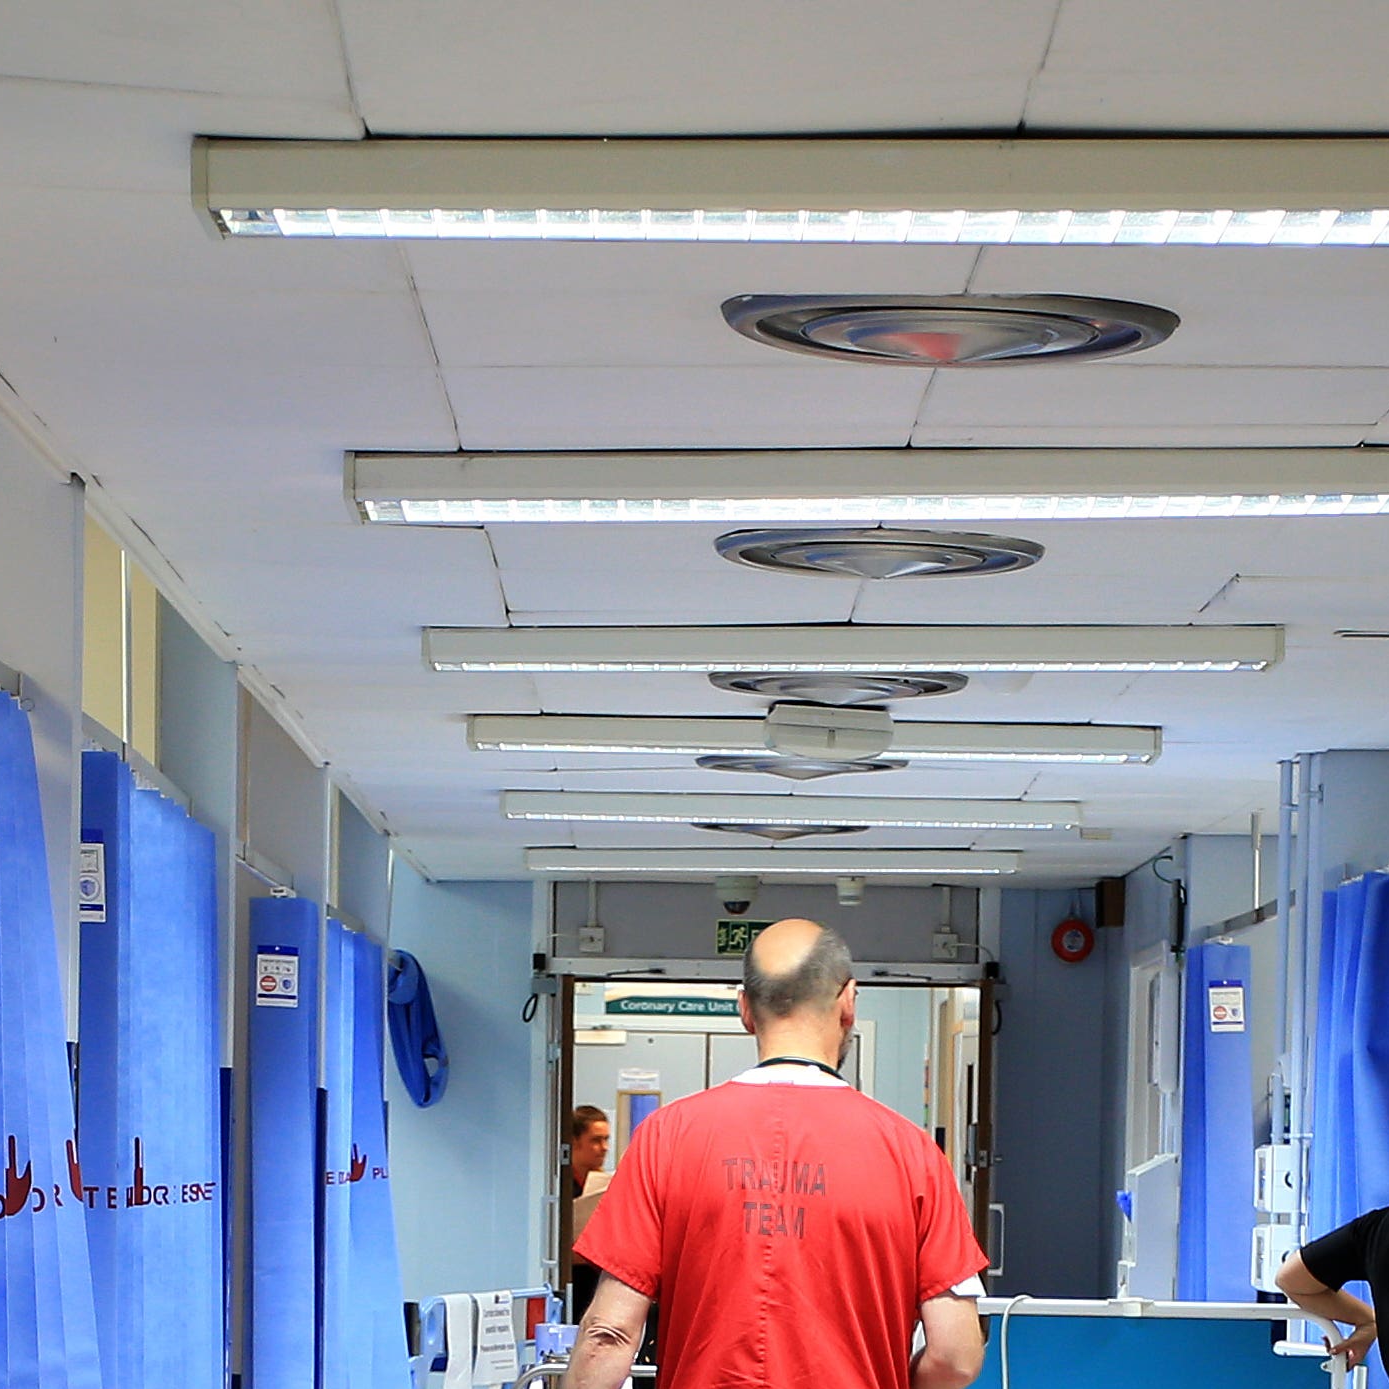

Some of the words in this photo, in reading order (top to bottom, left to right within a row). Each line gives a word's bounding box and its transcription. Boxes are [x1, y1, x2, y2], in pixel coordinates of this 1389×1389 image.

[620, 1000, 676, 1013] Coronary
[678, 1001, 705, 1012] Care
[708, 1000, 734, 1012] Unit
[722, 1157, 826, 1196] TRAUMA
[743, 1202, 805, 1240] TEAM
